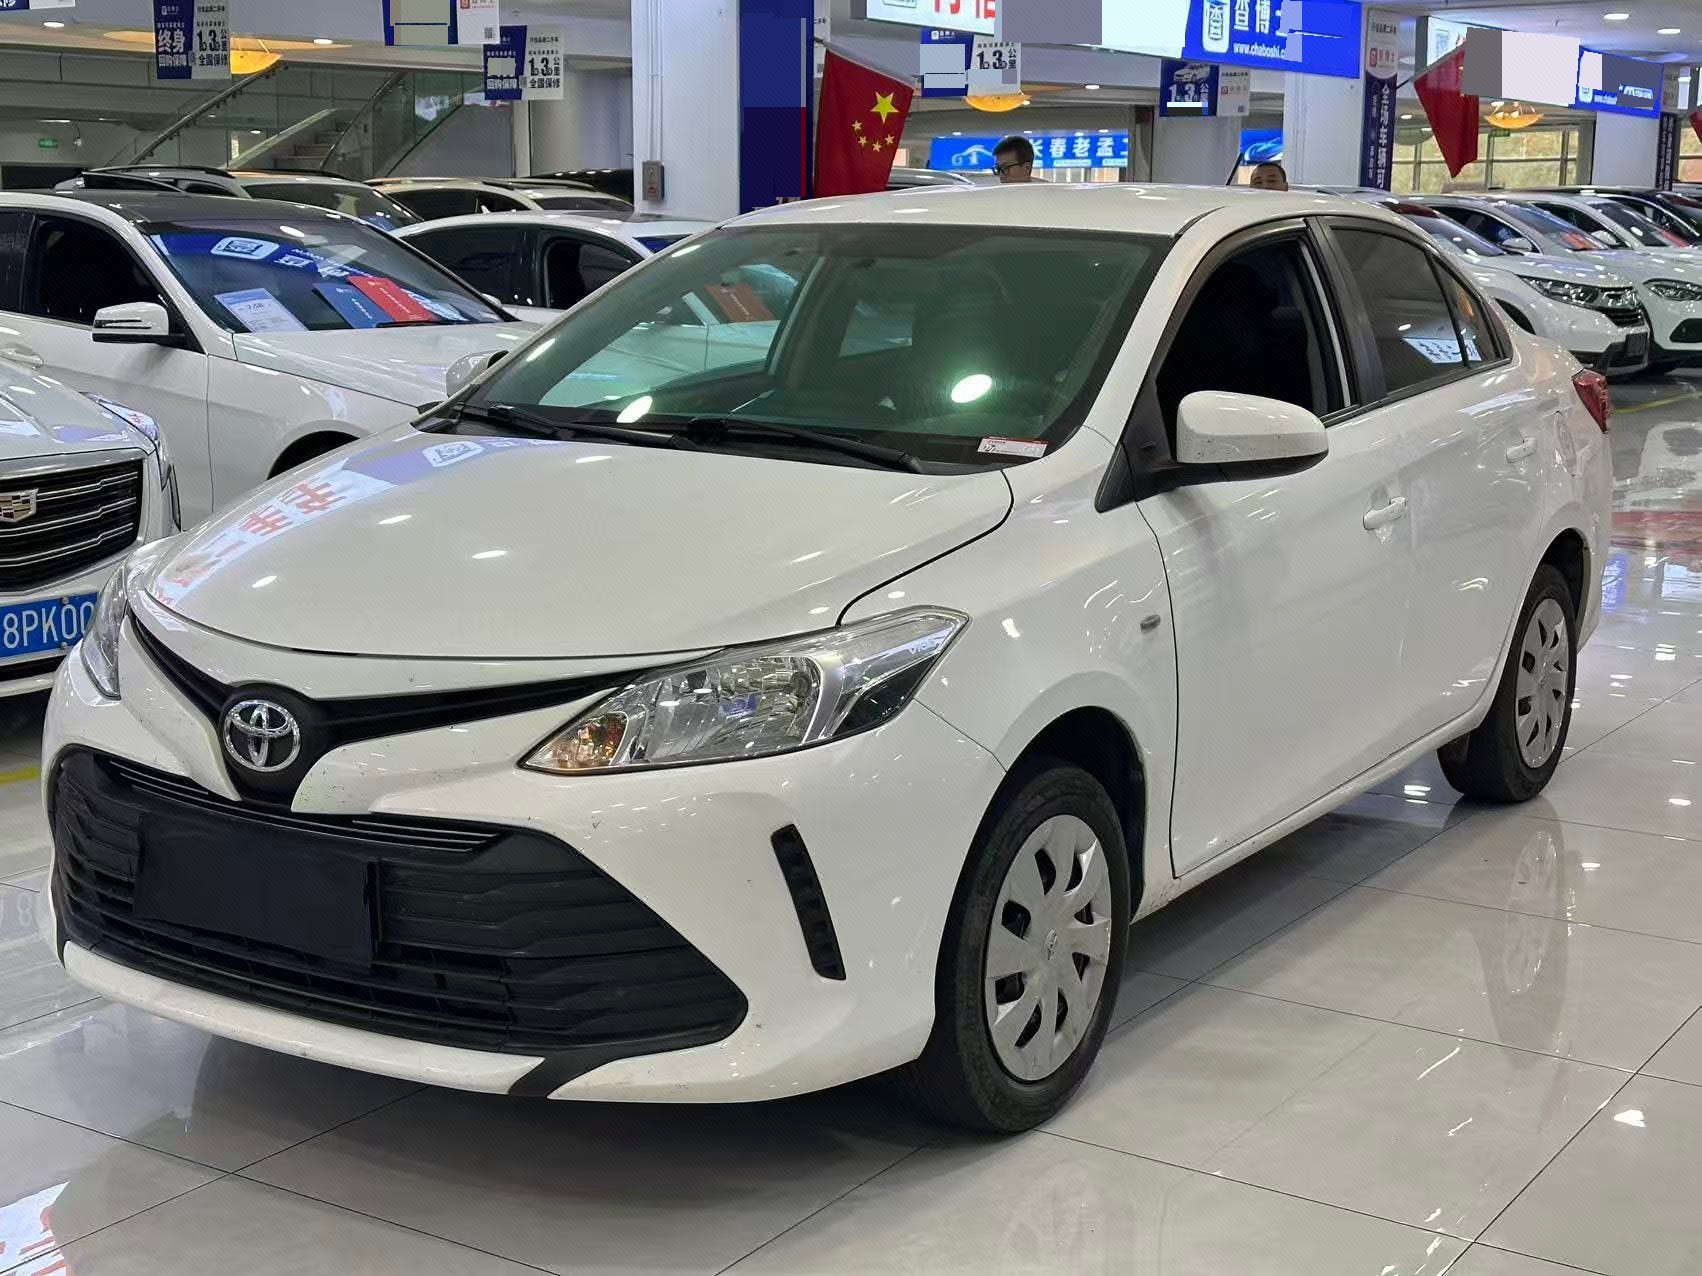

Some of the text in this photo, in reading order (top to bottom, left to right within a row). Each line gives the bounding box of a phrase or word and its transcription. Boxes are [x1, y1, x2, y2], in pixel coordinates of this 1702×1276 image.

[158, 29, 185, 52] 终身
[1232, 41, 1287, 59] www.chaboshi.c
[199, 53, 228, 66] 全国保修
[529, 78, 560, 88] 全国保修
